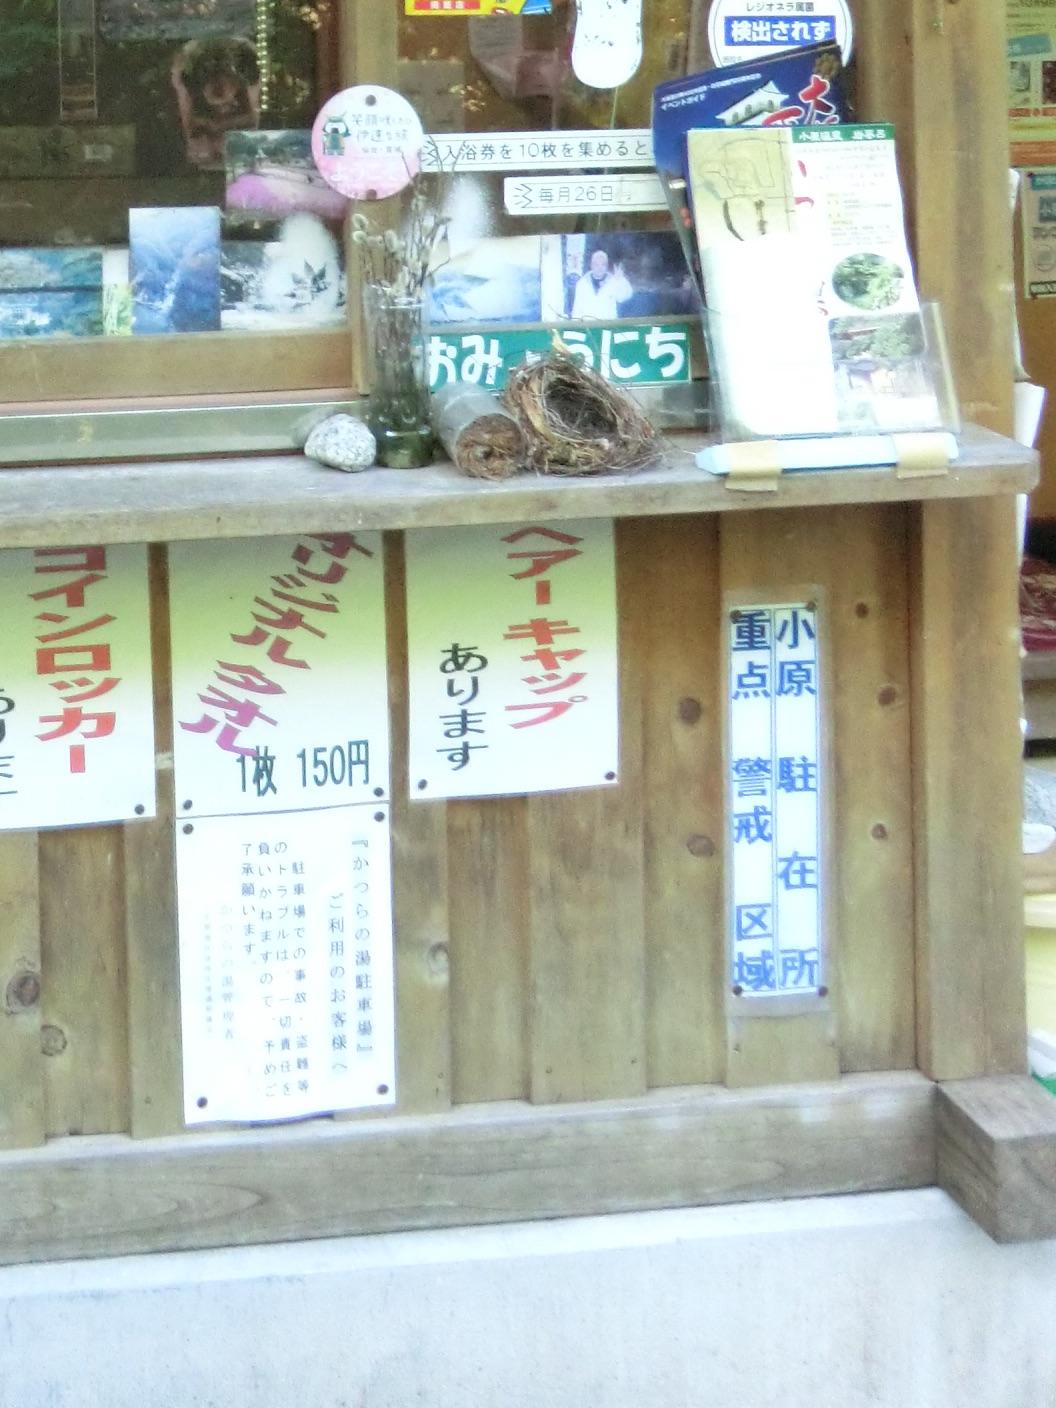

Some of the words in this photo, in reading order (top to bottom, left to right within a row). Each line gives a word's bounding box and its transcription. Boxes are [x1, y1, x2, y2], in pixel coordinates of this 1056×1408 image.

[731, 19, 831, 43] 検出されず
[429, 327, 688, 387] おみうにち
[28, 545, 122, 774] コインロッカー
[500, 526, 588, 729] ヘアーキャップ
[436, 643, 488, 771] あります
[236, 744, 277, 797] 1枚
[297, 739, 370, 789] 150円
